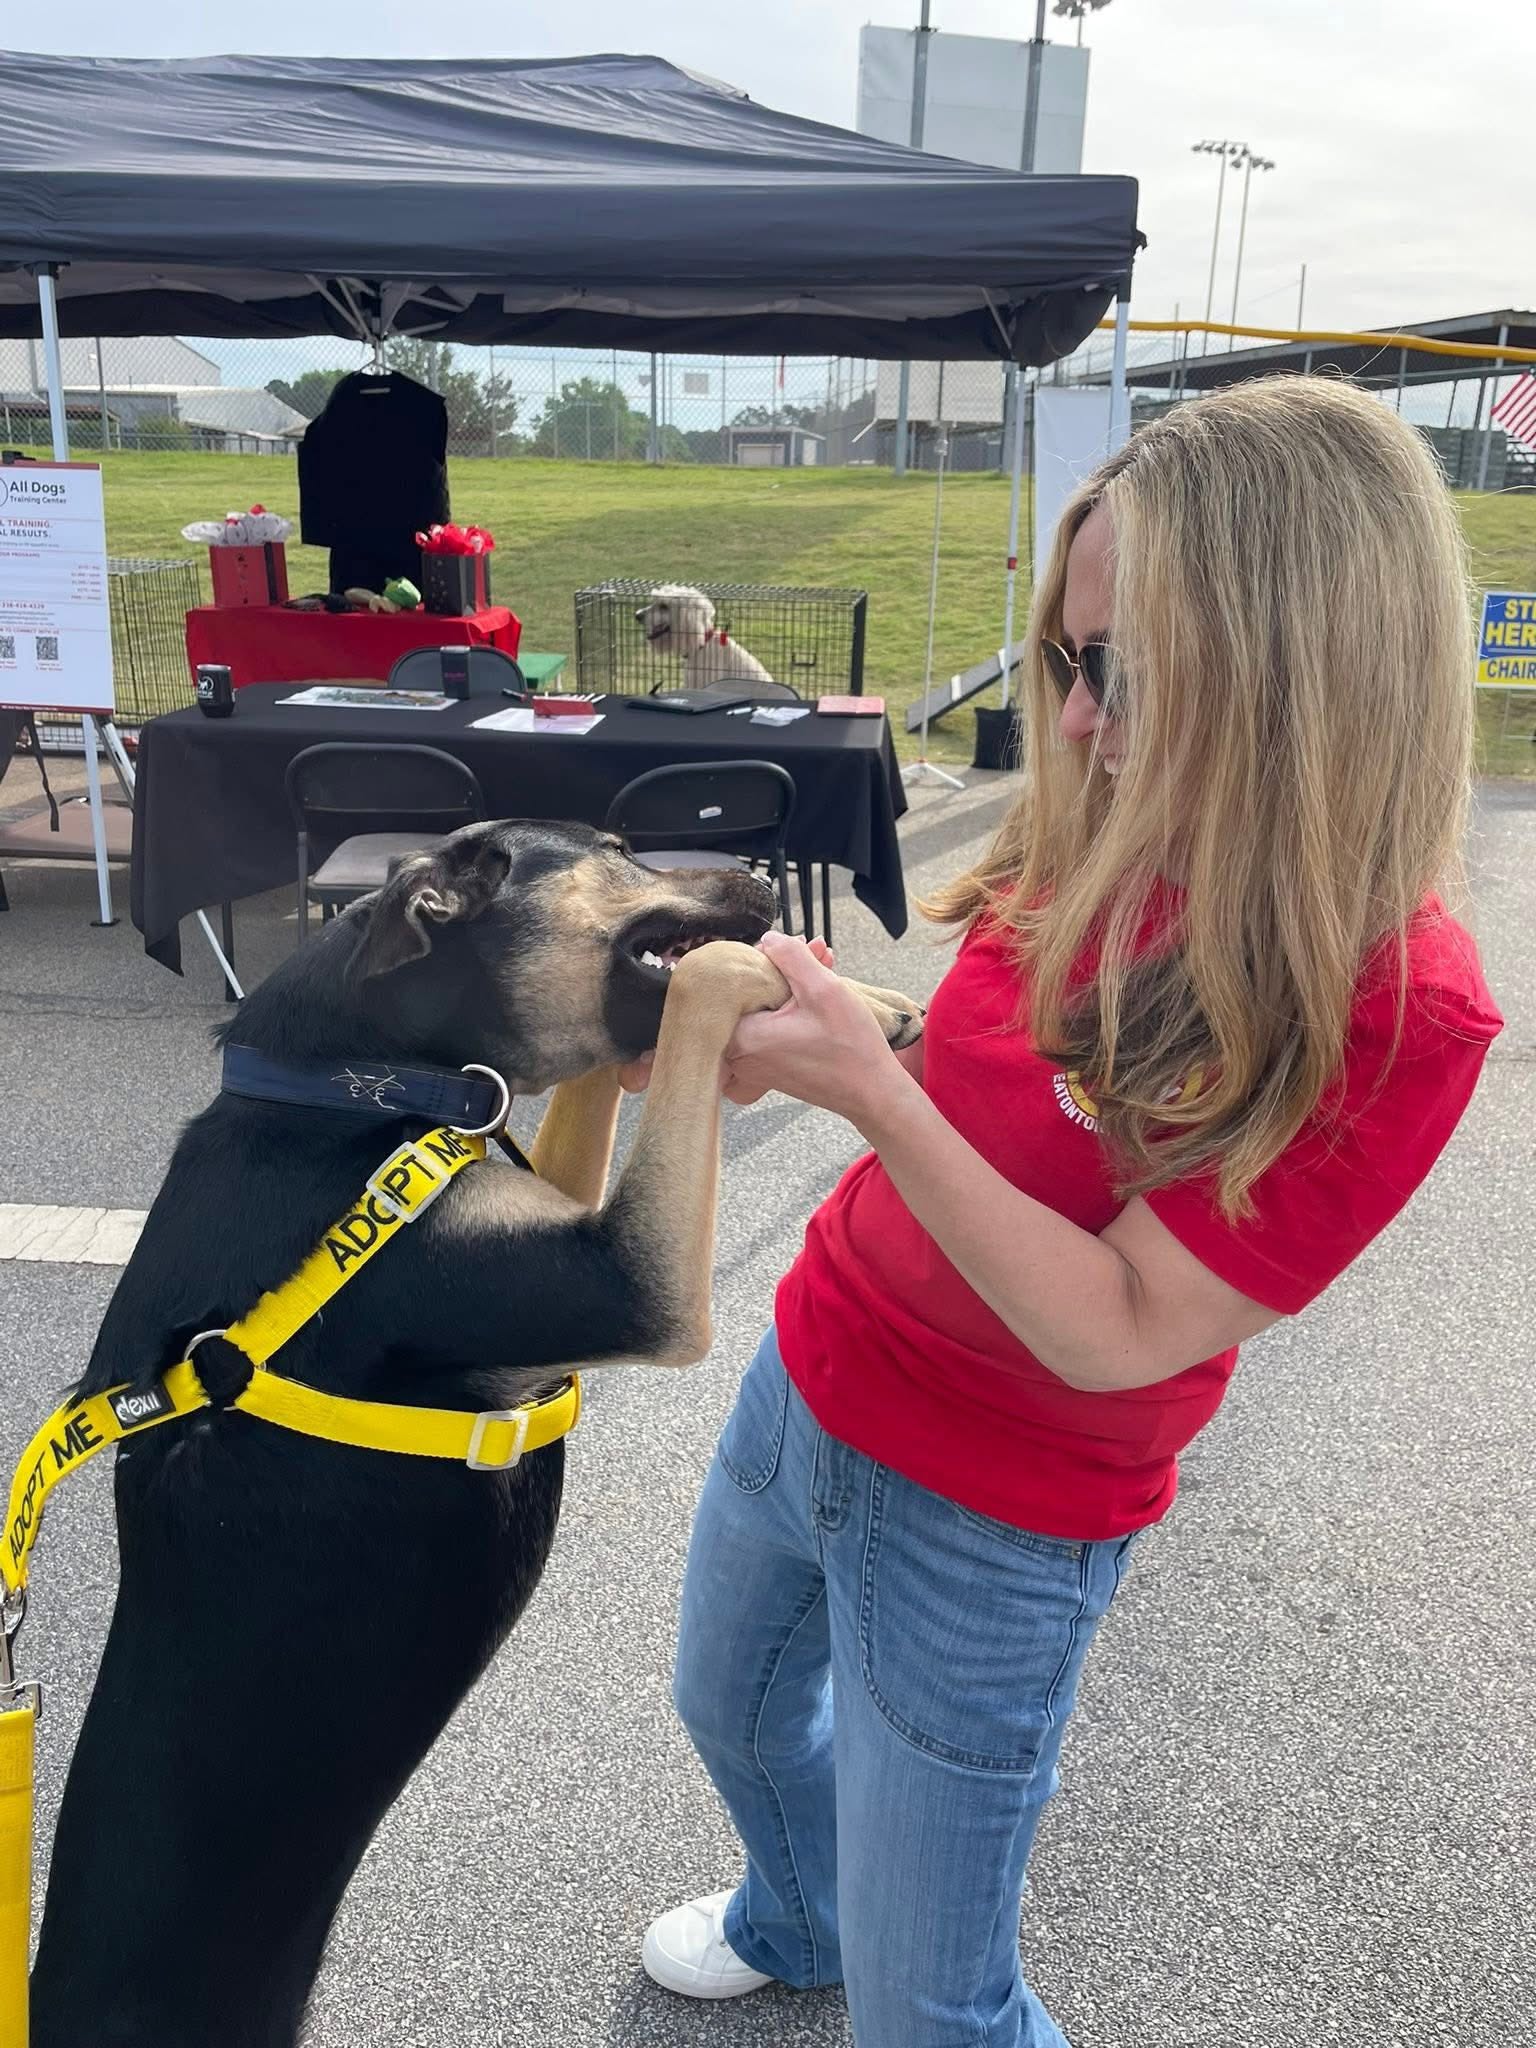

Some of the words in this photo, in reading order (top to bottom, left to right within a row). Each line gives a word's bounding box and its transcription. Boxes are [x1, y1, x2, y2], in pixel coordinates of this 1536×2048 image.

[10, 480, 28, 493] All
[31, 481, 66, 496] Dogs
[10, 495, 40, 504] Training
[42, 496, 67, 504] Center
[8, 519, 54, 529] TRAINING.
[10, 529, 51, 538] RESULTS.
[1487, 660, 1536, 678] CHAIR
[322, 1154, 436, 1273] ADOPT
[424, 1128, 472, 1168] ME
[9, 1450, 46, 1570] ADOPT
[50, 1411, 105, 1470] ME
